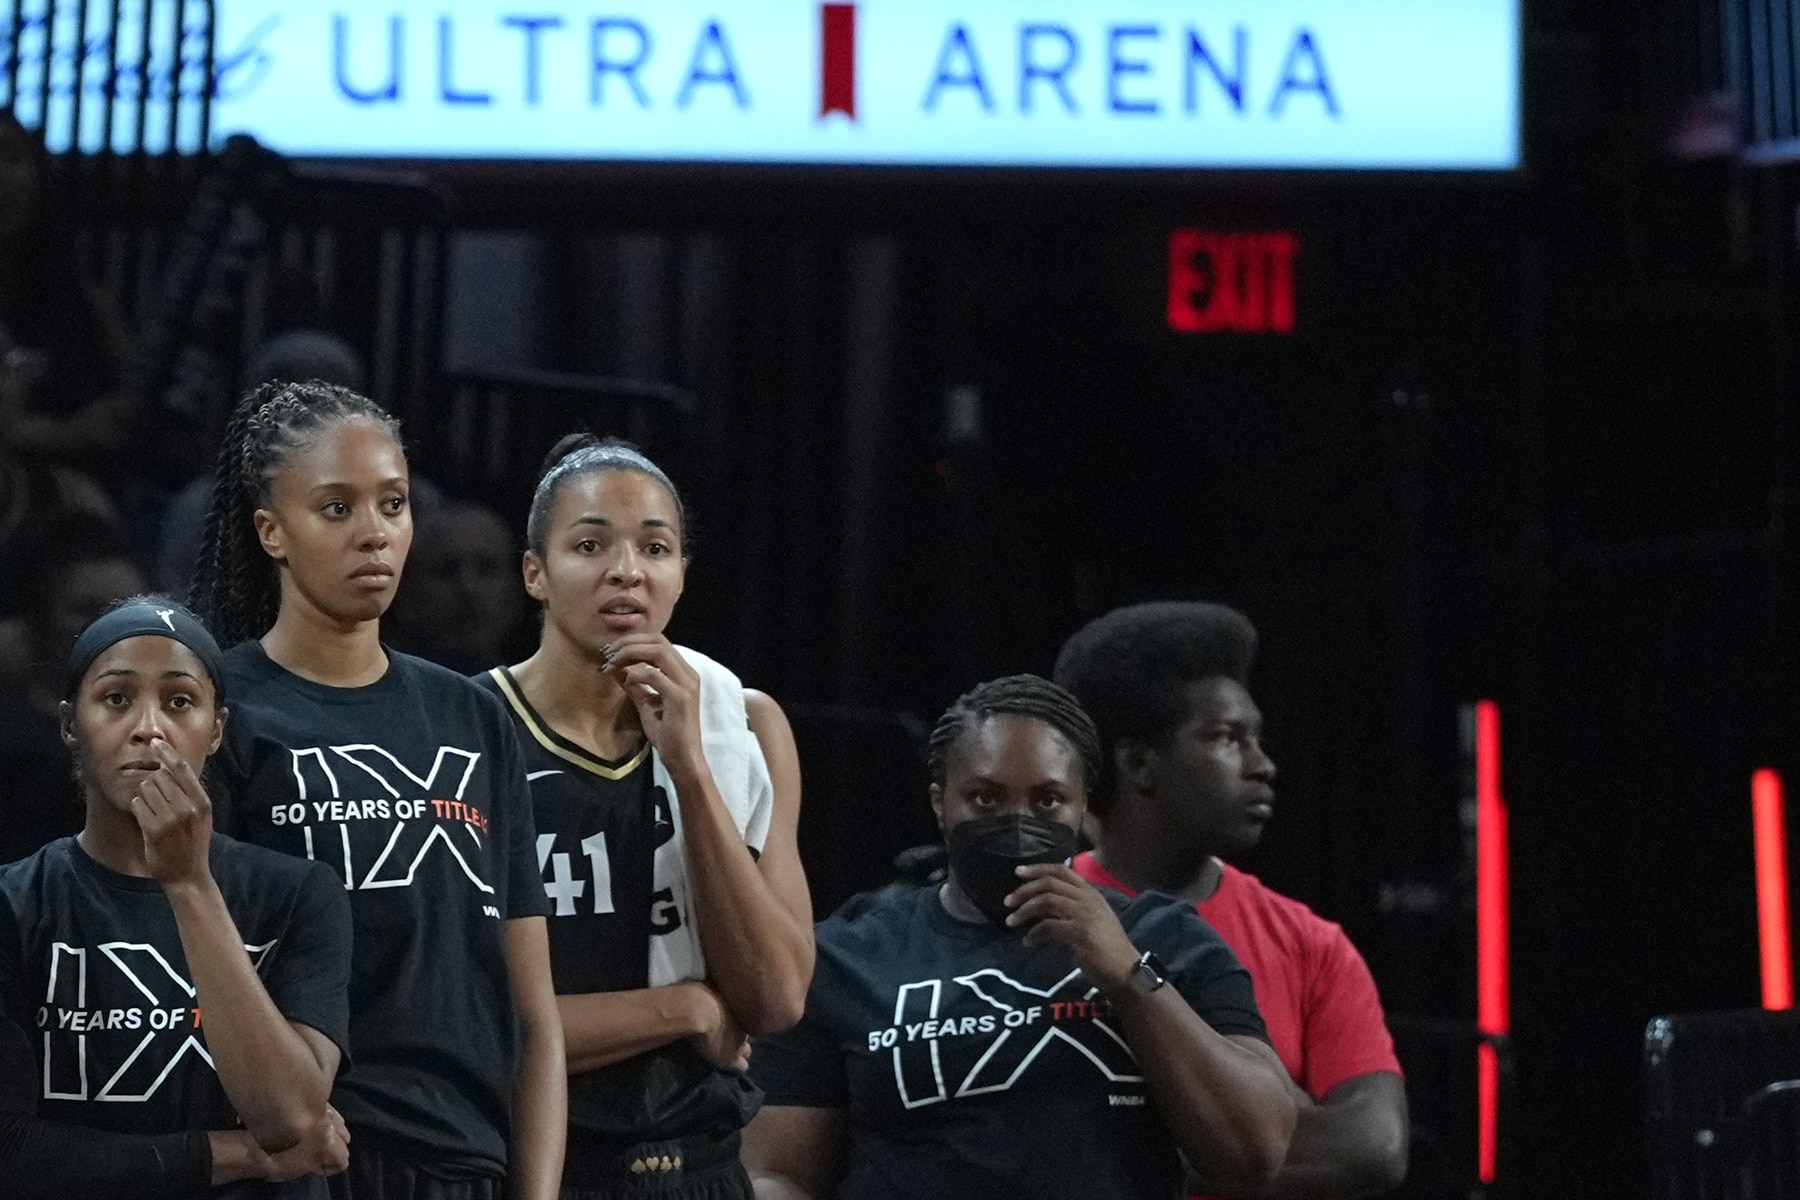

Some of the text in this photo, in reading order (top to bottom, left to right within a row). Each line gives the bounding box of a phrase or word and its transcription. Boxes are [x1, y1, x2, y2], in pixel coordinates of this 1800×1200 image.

[330, 14, 754, 112] ULTRA
[919, 20, 1345, 121] ARENA
[1168, 226, 1300, 335] EXIT
[271, 803, 306, 826] 50
[312, 799, 391, 821] YEARS
[395, 800, 426, 819] OF
[431, 799, 481, 828] TITLE
[536, 831, 615, 916] 41
[57, 1007, 142, 1031] YEARS
[149, 1007, 186, 1029] OF
[868, 1001, 1102, 1051] 50 YEARS OF TITL
